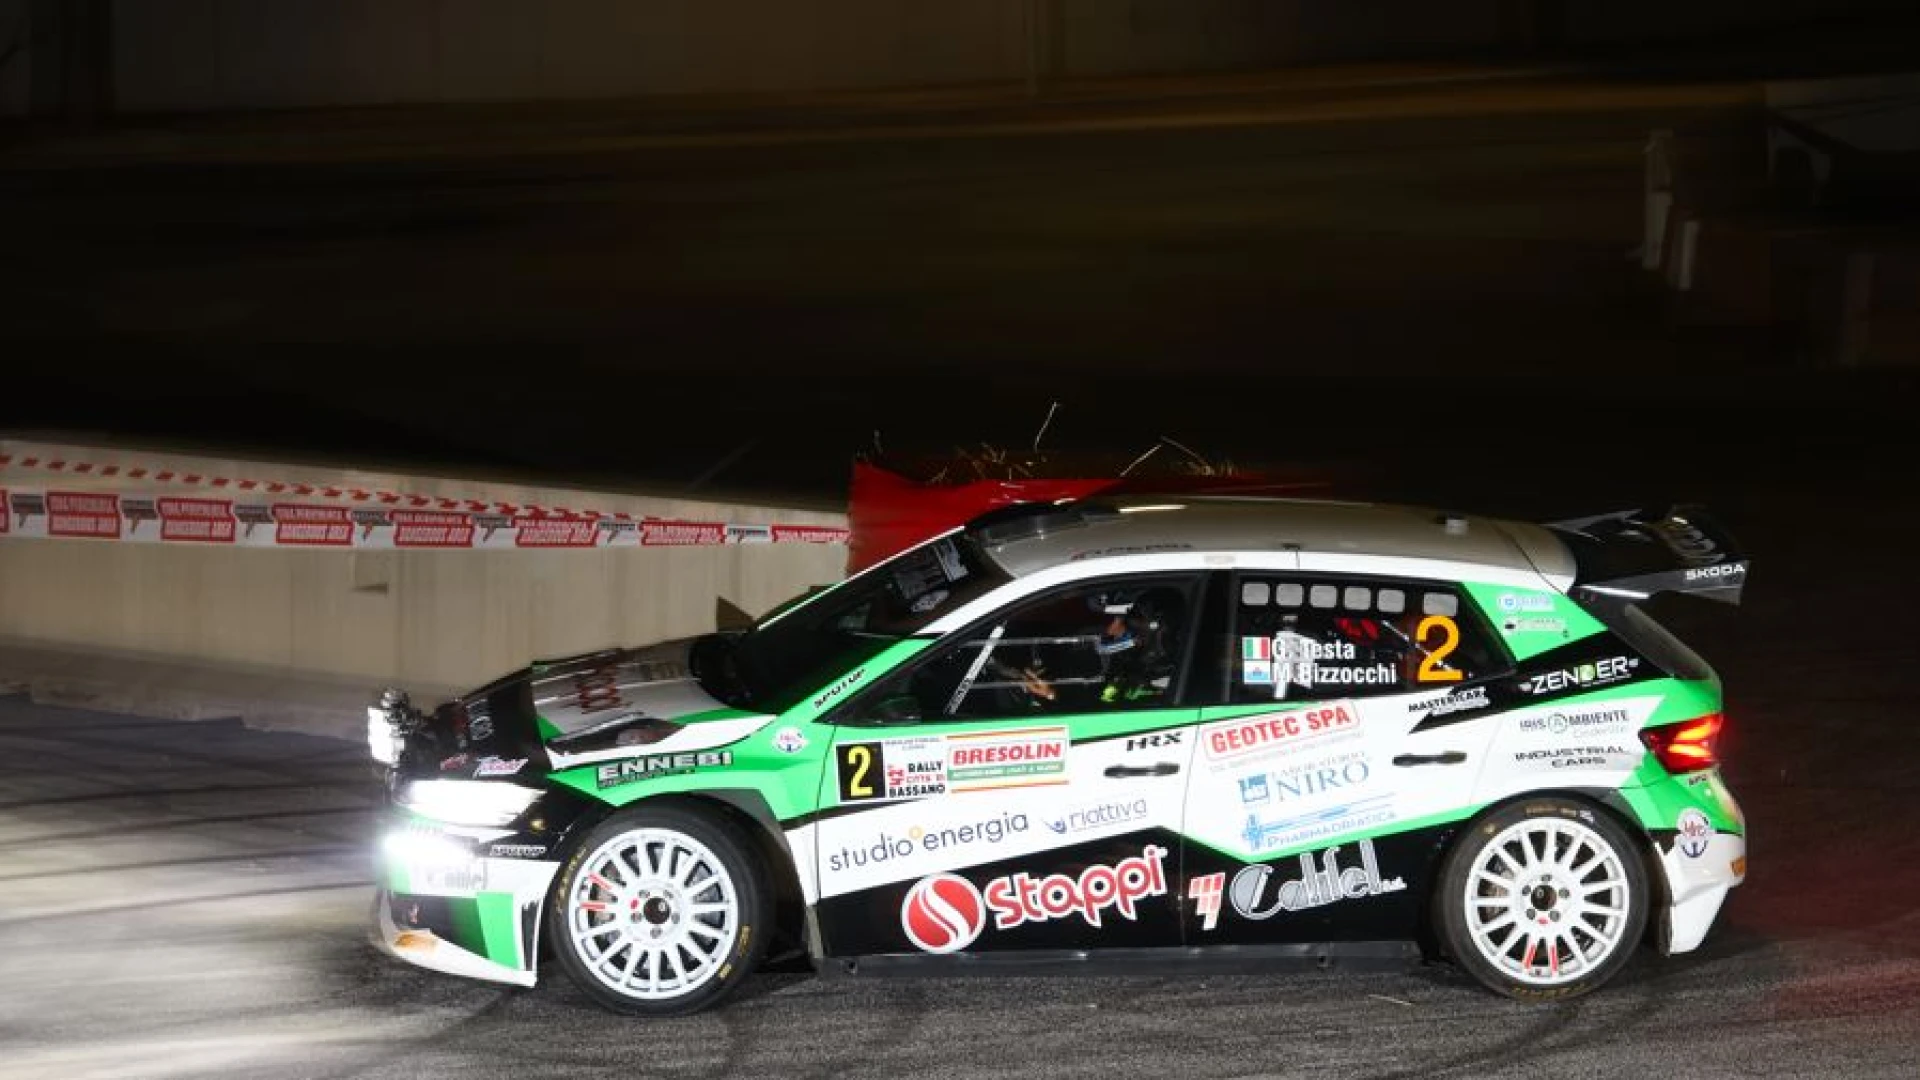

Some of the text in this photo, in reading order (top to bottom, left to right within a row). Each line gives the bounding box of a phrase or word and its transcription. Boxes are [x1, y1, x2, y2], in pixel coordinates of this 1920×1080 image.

[1686, 564, 1745, 580] SKODA
[1302, 638, 1357, 660] Testa
[1416, 616, 1464, 681] 2
[1531, 656, 1629, 694] ZENDER
[1126, 732, 1182, 751] HRX
[1211, 717, 1301, 753] GEOTEC
[1306, 706, 1351, 730] SPA
[598, 750, 733, 781] ENNEBI
[848, 745, 873, 797] 2
[907, 760, 943, 773] RALLY
[953, 742, 1062, 766] BRESOLIN
[889, 784, 945, 798] BASSANO
[1276, 760, 1370, 802] NIRO
[829, 811, 1029, 872] studio energia
[983, 845, 1168, 931] Stappi
